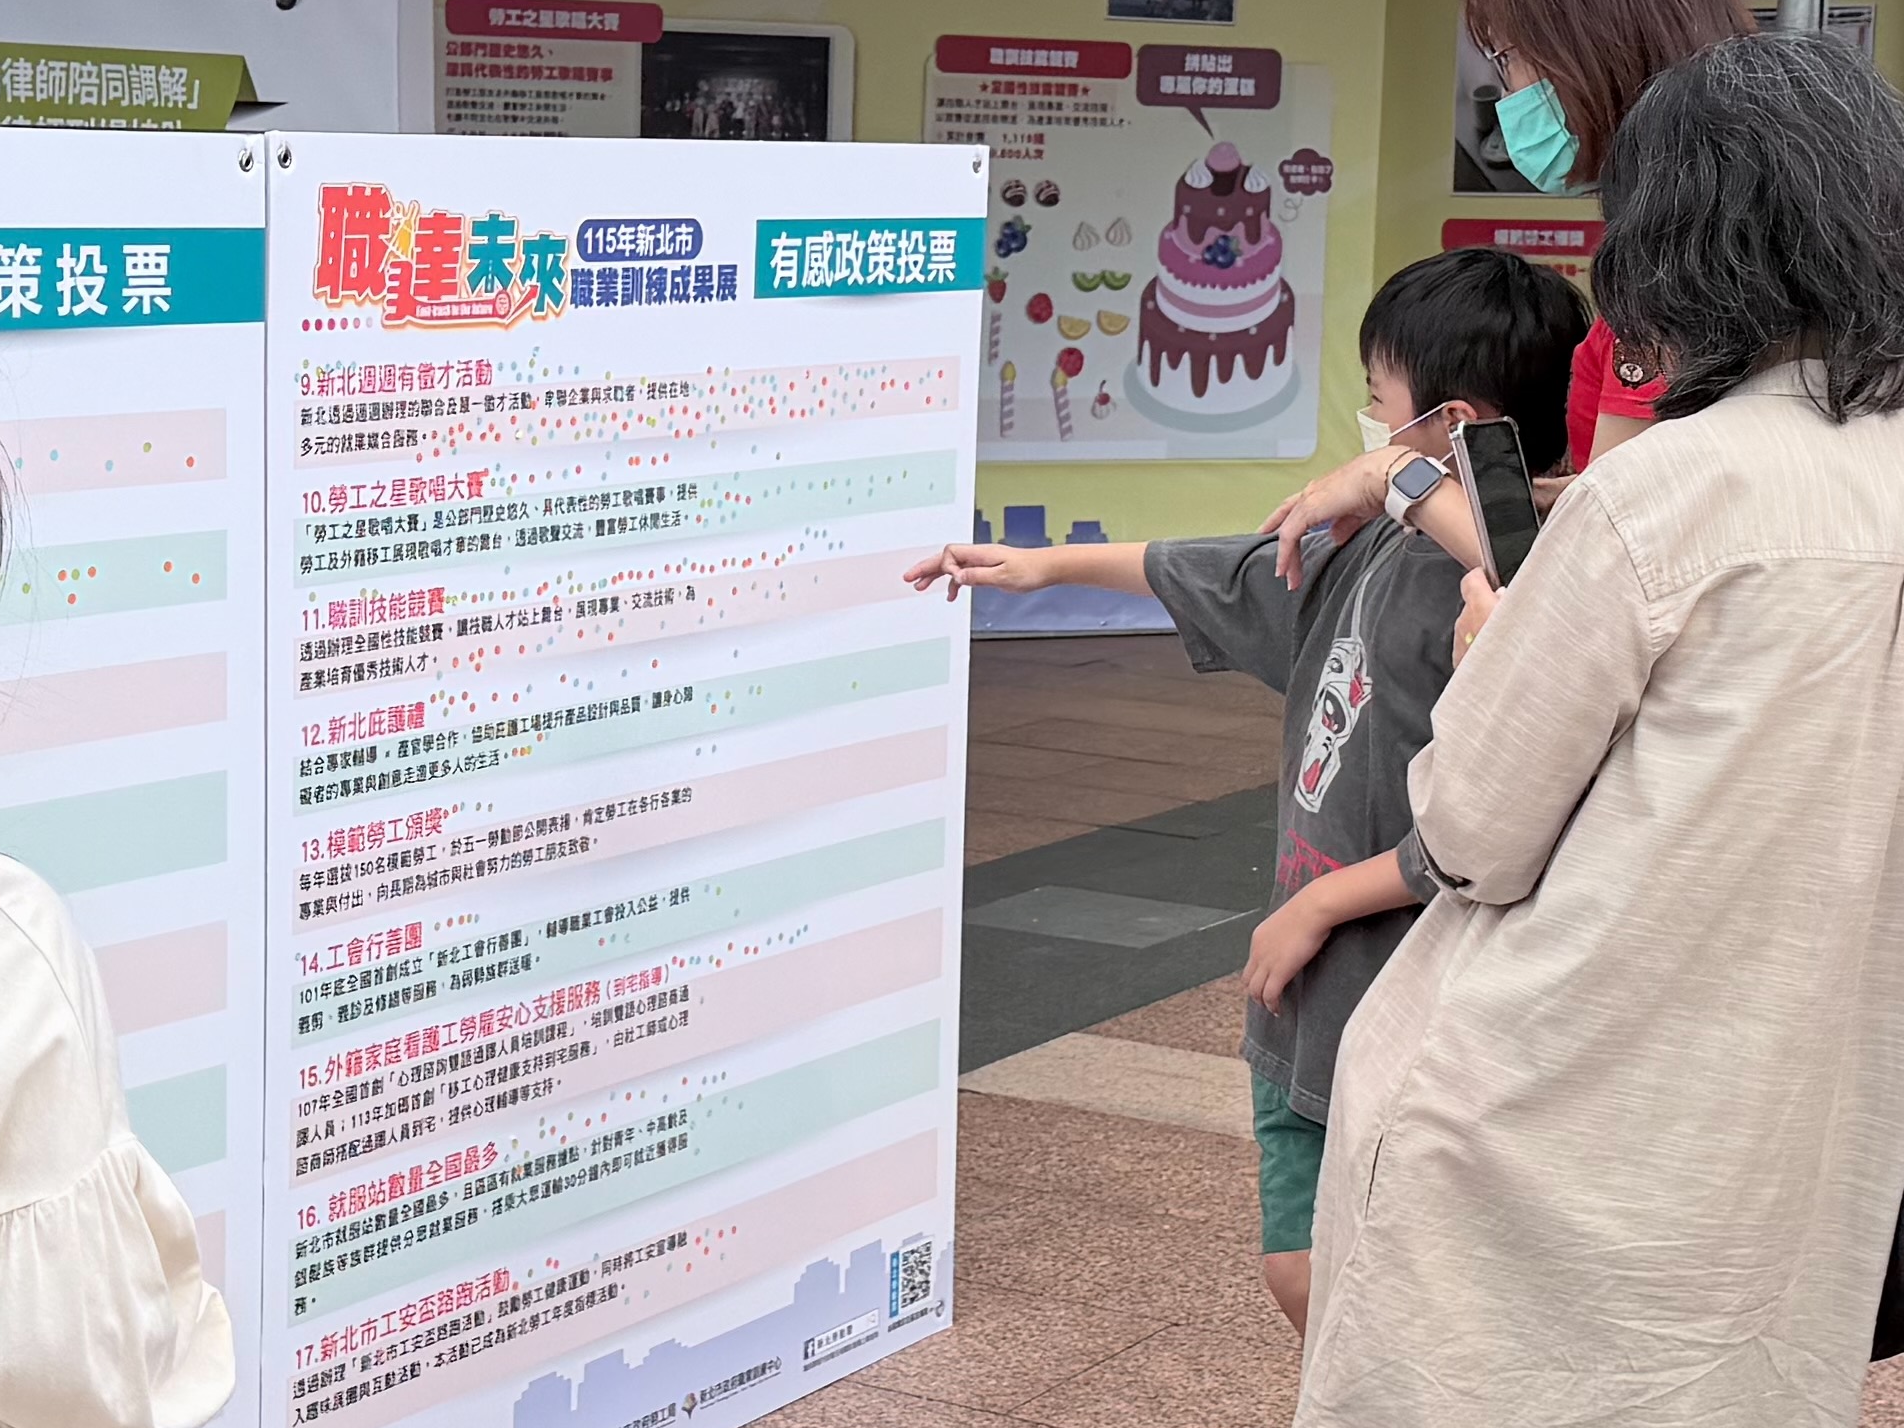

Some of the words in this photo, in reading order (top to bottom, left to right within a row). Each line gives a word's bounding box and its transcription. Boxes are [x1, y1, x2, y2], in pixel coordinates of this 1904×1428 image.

[583, 223, 694, 256] 115年新北市
[770, 230, 957, 290] 有感政策投票
[570, 264, 737, 309] 職業訓練成果展
[301, 359, 492, 396] 9.新北週週有徵才活動
[303, 469, 484, 513] 10.勞工之星歌唱大賽
[303, 588, 445, 632] 11.職訓技能競賽
[302, 703, 425, 746] 12.新北庇護禮
[302, 807, 442, 862] 13.模範勞工頒獎
[300, 921, 422, 976] 14.工會行善團
[296, 1267, 510, 1369] 17.新北市工安盃路跑活動
